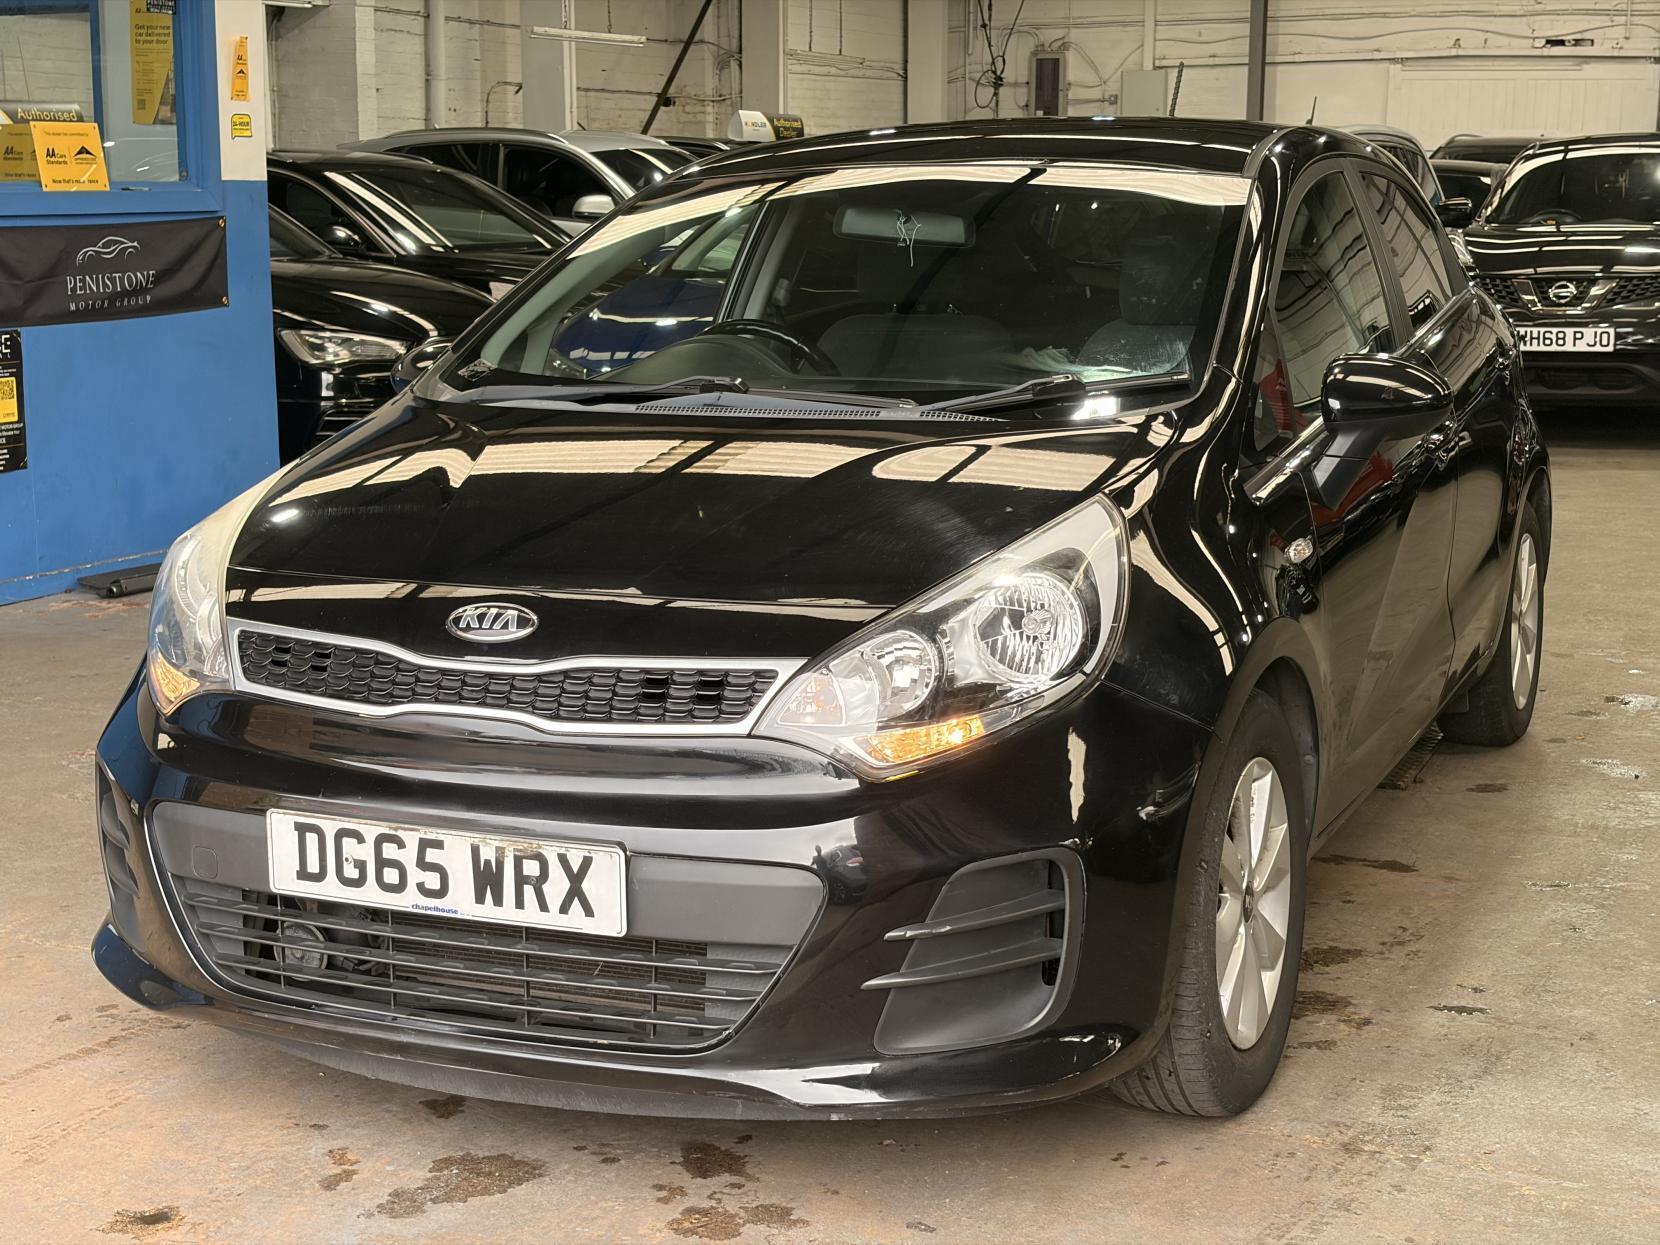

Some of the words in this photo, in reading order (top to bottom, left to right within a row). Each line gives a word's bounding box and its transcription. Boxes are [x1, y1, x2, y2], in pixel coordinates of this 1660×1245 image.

[17, 106, 78, 121] Authorised
[46, 147, 56, 159] AA
[66, 270, 156, 295] PENISTONE
[69, 299, 109, 312] MOTOR
[116, 294, 151, 307] GROUP
[1572, 330, 1611, 347] PJO
[459, 607, 519, 632] KIA
[293, 820, 450, 900] DG65
[470, 842, 596, 919] WRX
[411, 903, 458, 915] chapelhouse
